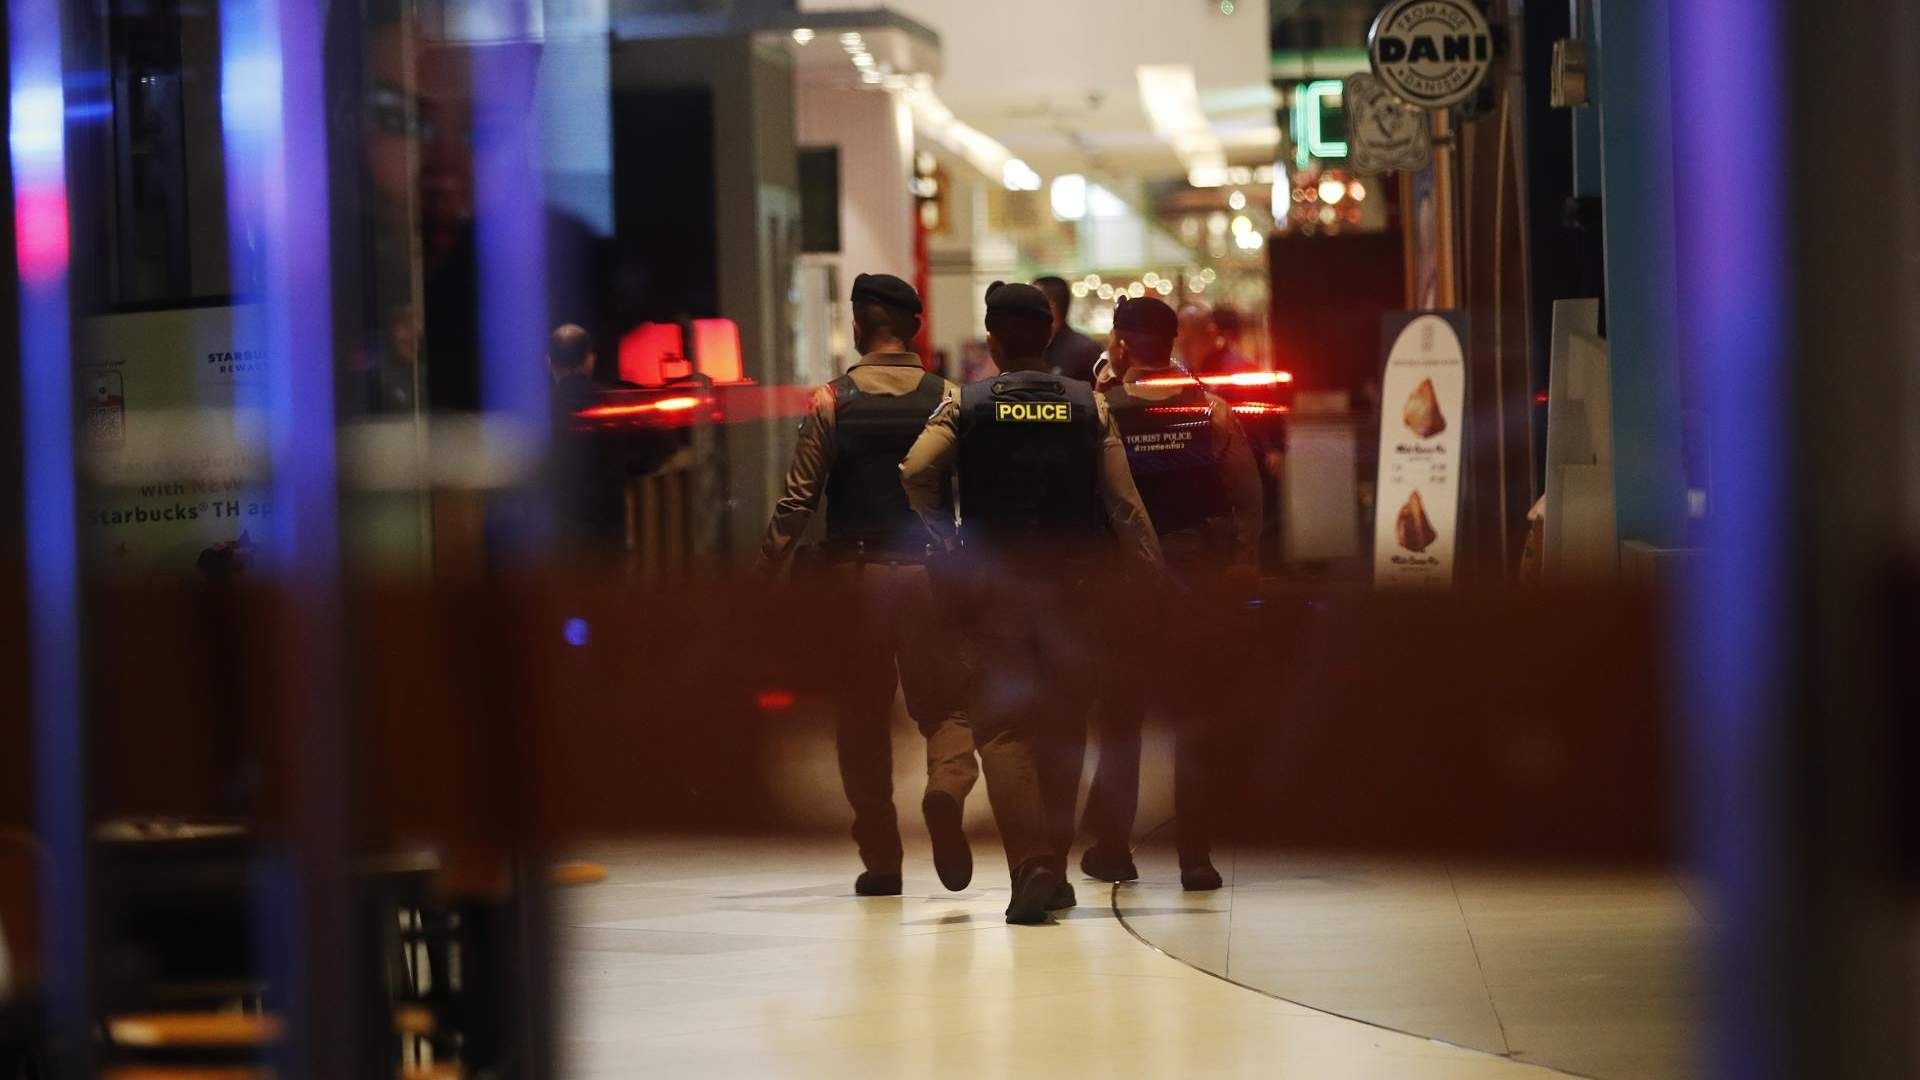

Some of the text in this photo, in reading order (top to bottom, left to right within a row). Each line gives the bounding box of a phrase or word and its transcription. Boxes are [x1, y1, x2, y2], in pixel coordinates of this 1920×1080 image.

[1396, 3, 1468, 29] FROMAGE
[1379, 34, 1487, 64] DANI
[999, 404, 1068, 420] POLICE
[1126, 431, 1192, 443] TOURIST POLICE
[140, 480, 184, 497] with
[213, 501, 240, 517] TH
[248, 502, 273, 520] ap
